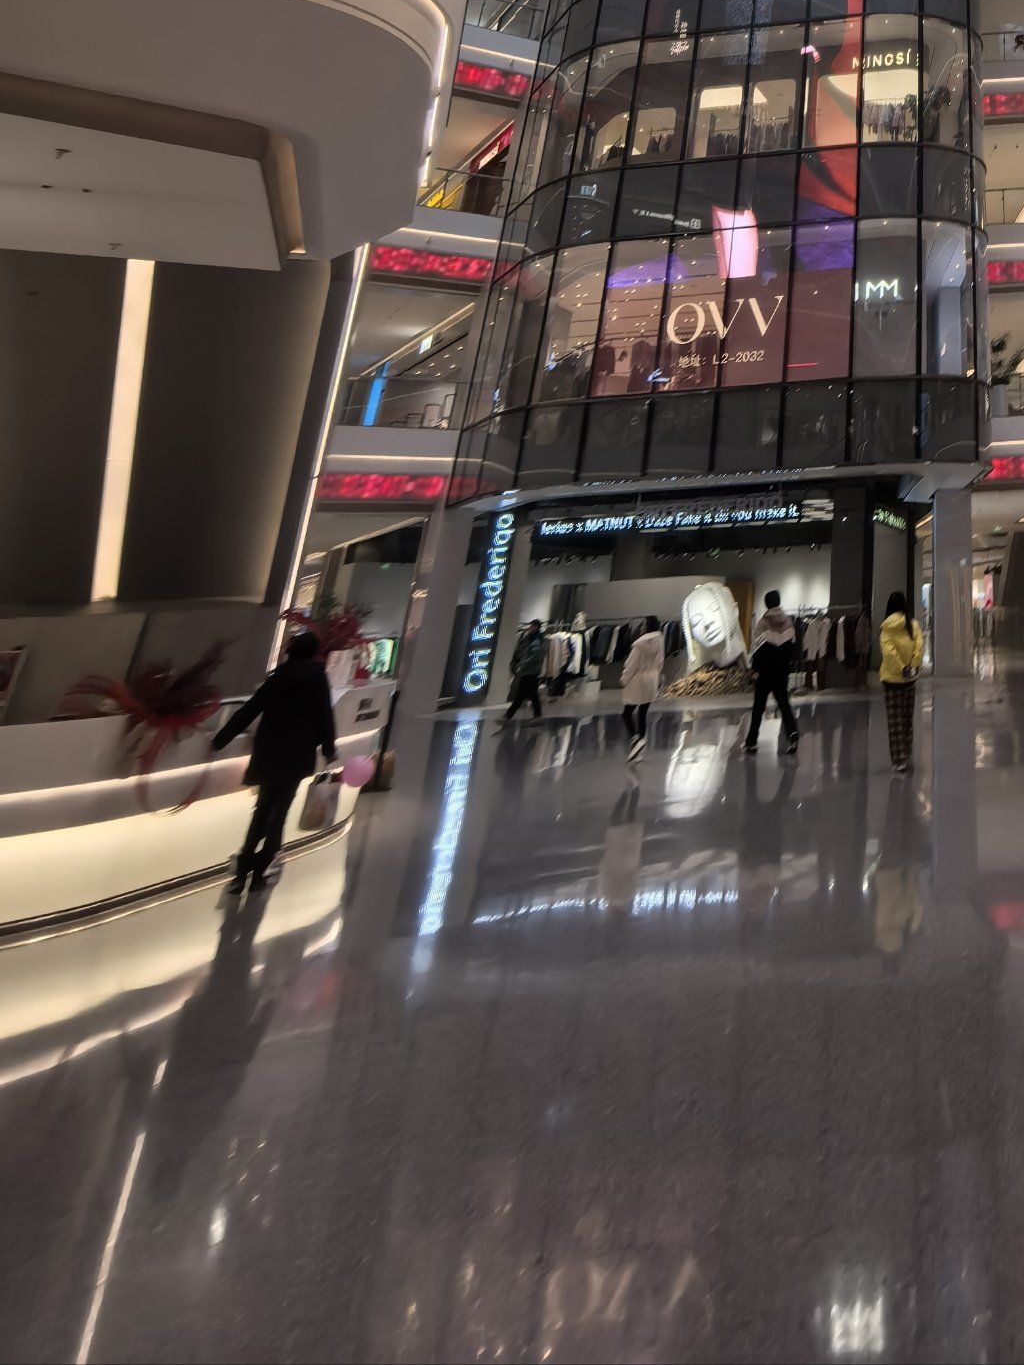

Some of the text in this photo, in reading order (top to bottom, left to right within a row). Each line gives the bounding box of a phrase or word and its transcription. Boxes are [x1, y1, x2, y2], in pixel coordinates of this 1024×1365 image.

[667, 295, 785, 344] OVV
[712, 350, 765, 365] L2-2032
[463, 513, 515, 693] Ori Frederiqo
